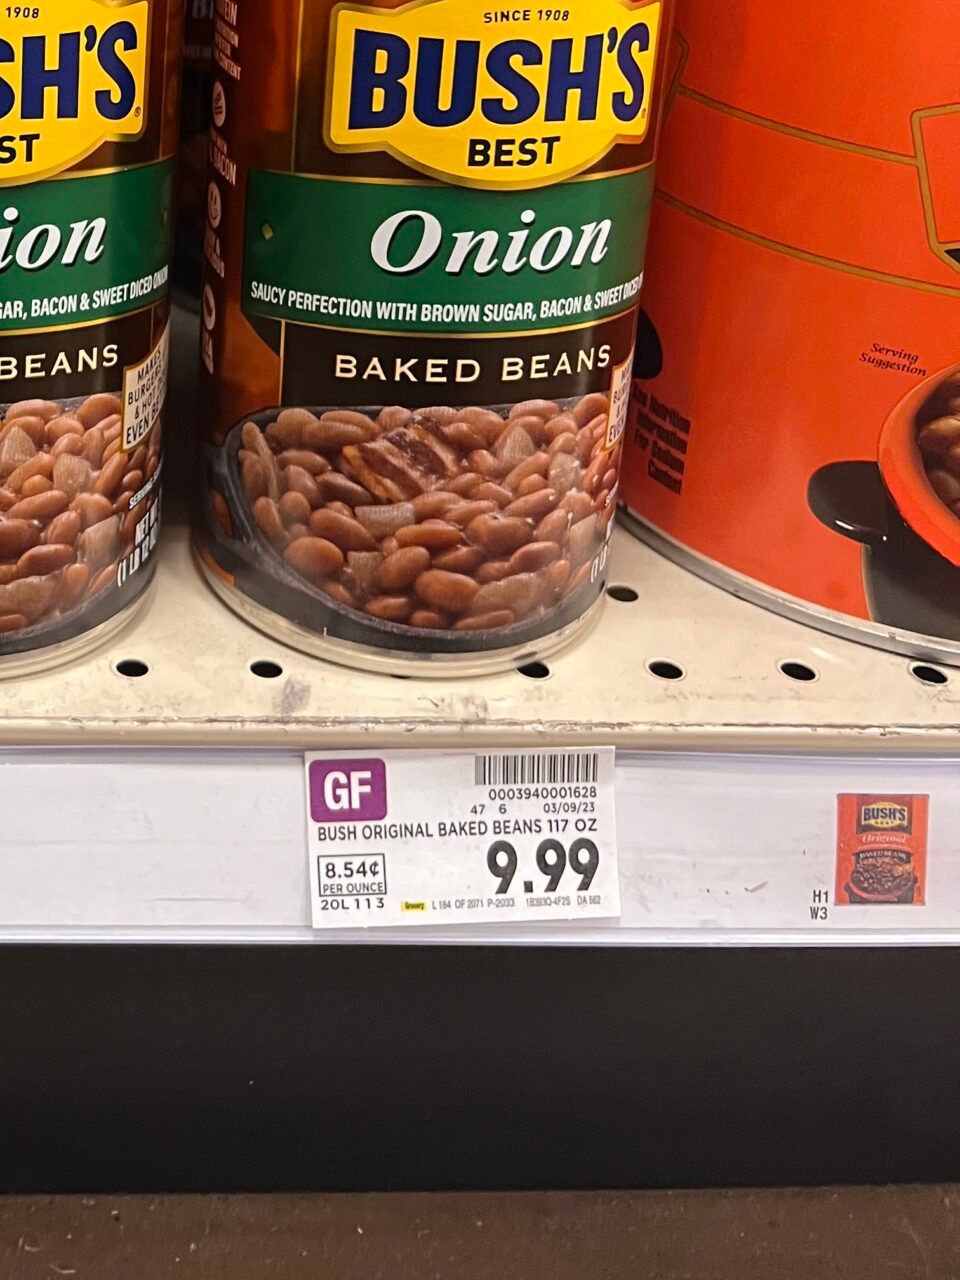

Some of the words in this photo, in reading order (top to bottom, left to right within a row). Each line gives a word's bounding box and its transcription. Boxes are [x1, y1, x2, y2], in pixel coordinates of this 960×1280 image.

[5, 6, 40, 19] 1908
[483, 10, 531, 24] SINCE
[537, 9, 570, 22] 1908
[348, 22, 649, 130] BUSH'S
[467, 136, 561, 167] BEST
[370, 209, 612, 274] Onion
[870, 342, 919, 364] Serving
[335, 354, 481, 383] BAKED
[501, 344, 611, 382] BEANS
[858, 352, 927, 377] Suggestion
[323, 770, 372, 811] GF
[488, 786, 597, 800] 0003940001628
[470, 804, 485, 815] 47
[498, 804, 507, 814] 6
[543, 802, 595, 814] 03/09/23
[863, 807, 906, 821] BUSH'S
[318, 826, 357, 841] BUSH
[362, 823, 433, 840] ORIGINAL
[439, 821, 488, 837] BAKED
[493, 819, 541, 834] BEANS
[548, 819, 569, 832] 117
[575, 818, 598, 832] OZ
[325, 861, 380, 879] 8.54¢
[487, 837, 600, 894] 9.99
[322, 883, 343, 894] PER
[346, 882, 383, 894] OUNCE
[813, 890, 829, 903] H1
[320, 899, 350, 910] 20L
[810, 907, 828, 919] W3
